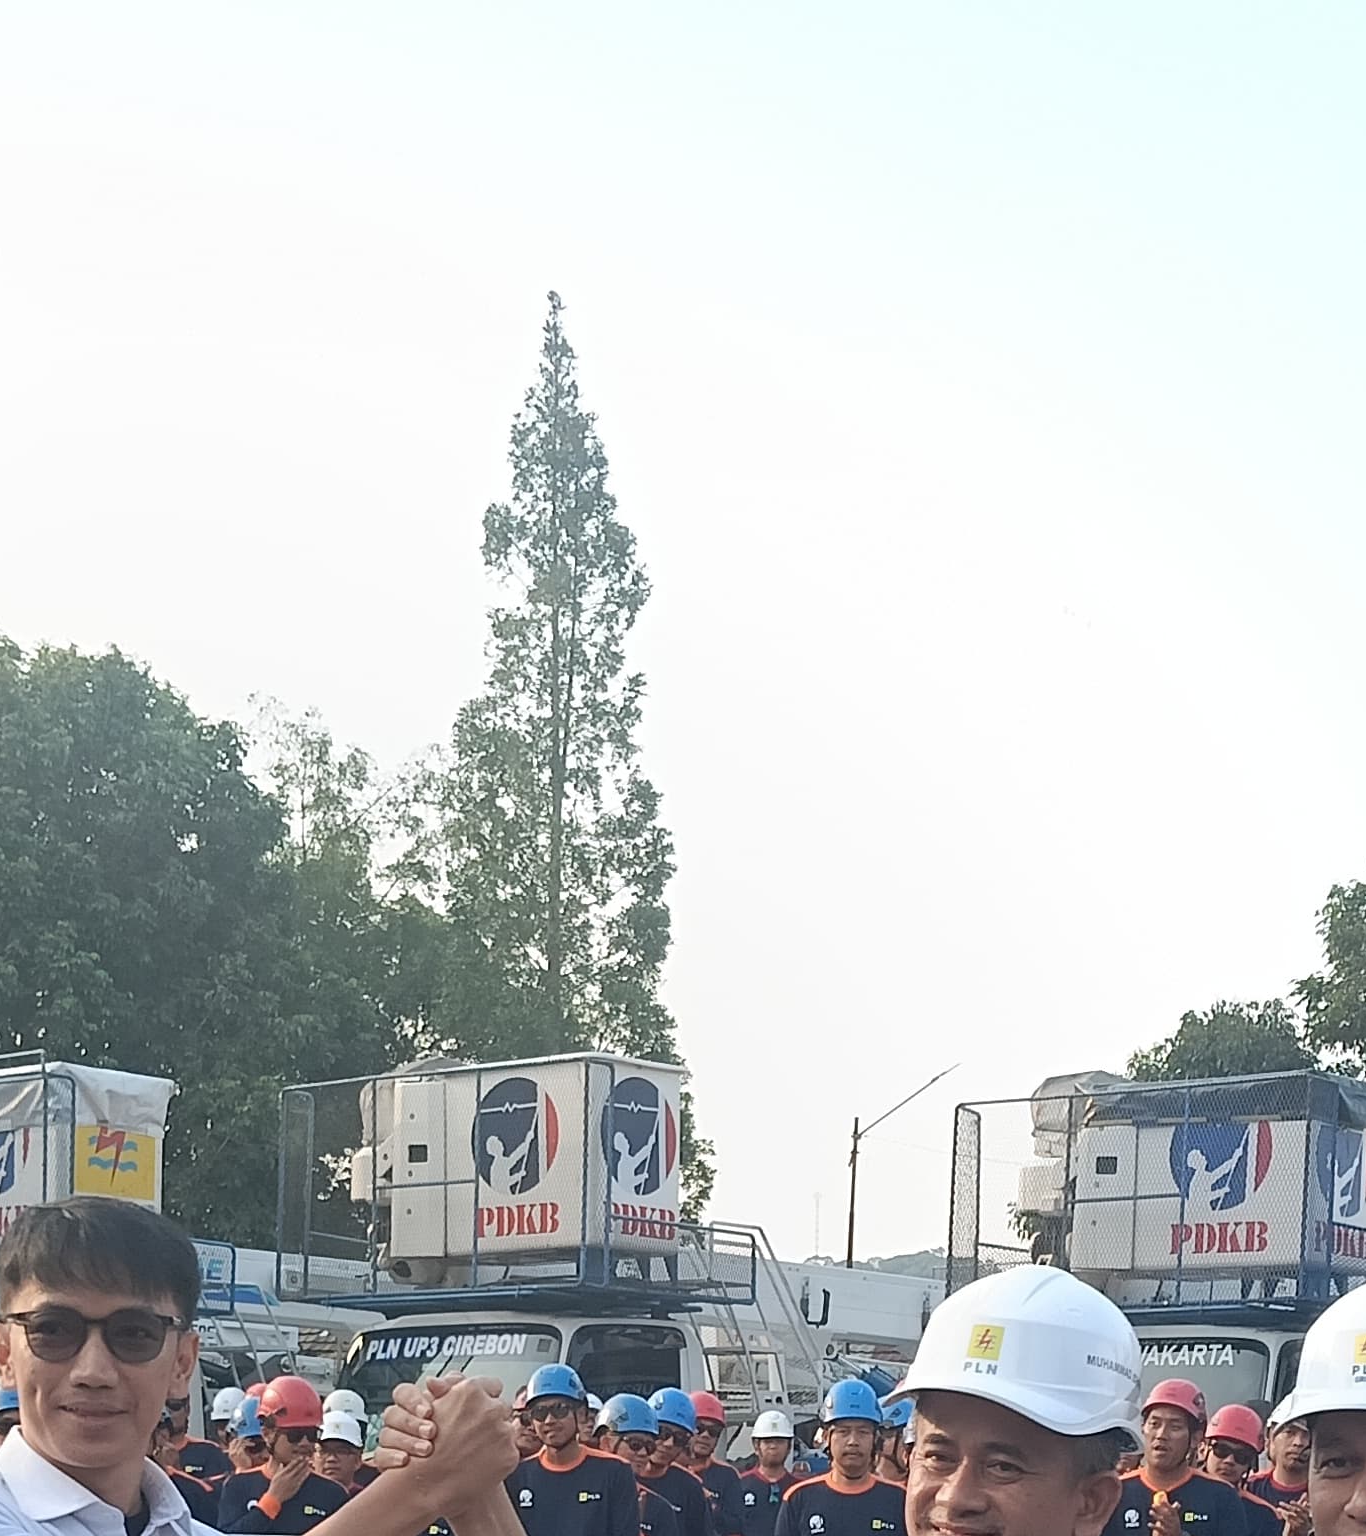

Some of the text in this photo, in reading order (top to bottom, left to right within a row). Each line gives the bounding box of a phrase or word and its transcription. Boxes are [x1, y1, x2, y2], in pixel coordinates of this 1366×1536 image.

[477, 1203, 559, 1238] PDKB
[1169, 1220, 1269, 1255] PDKB
[366, 1333, 527, 1362] PLN UP3 CIREBON
[963, 1360, 998, 1376] PLN
